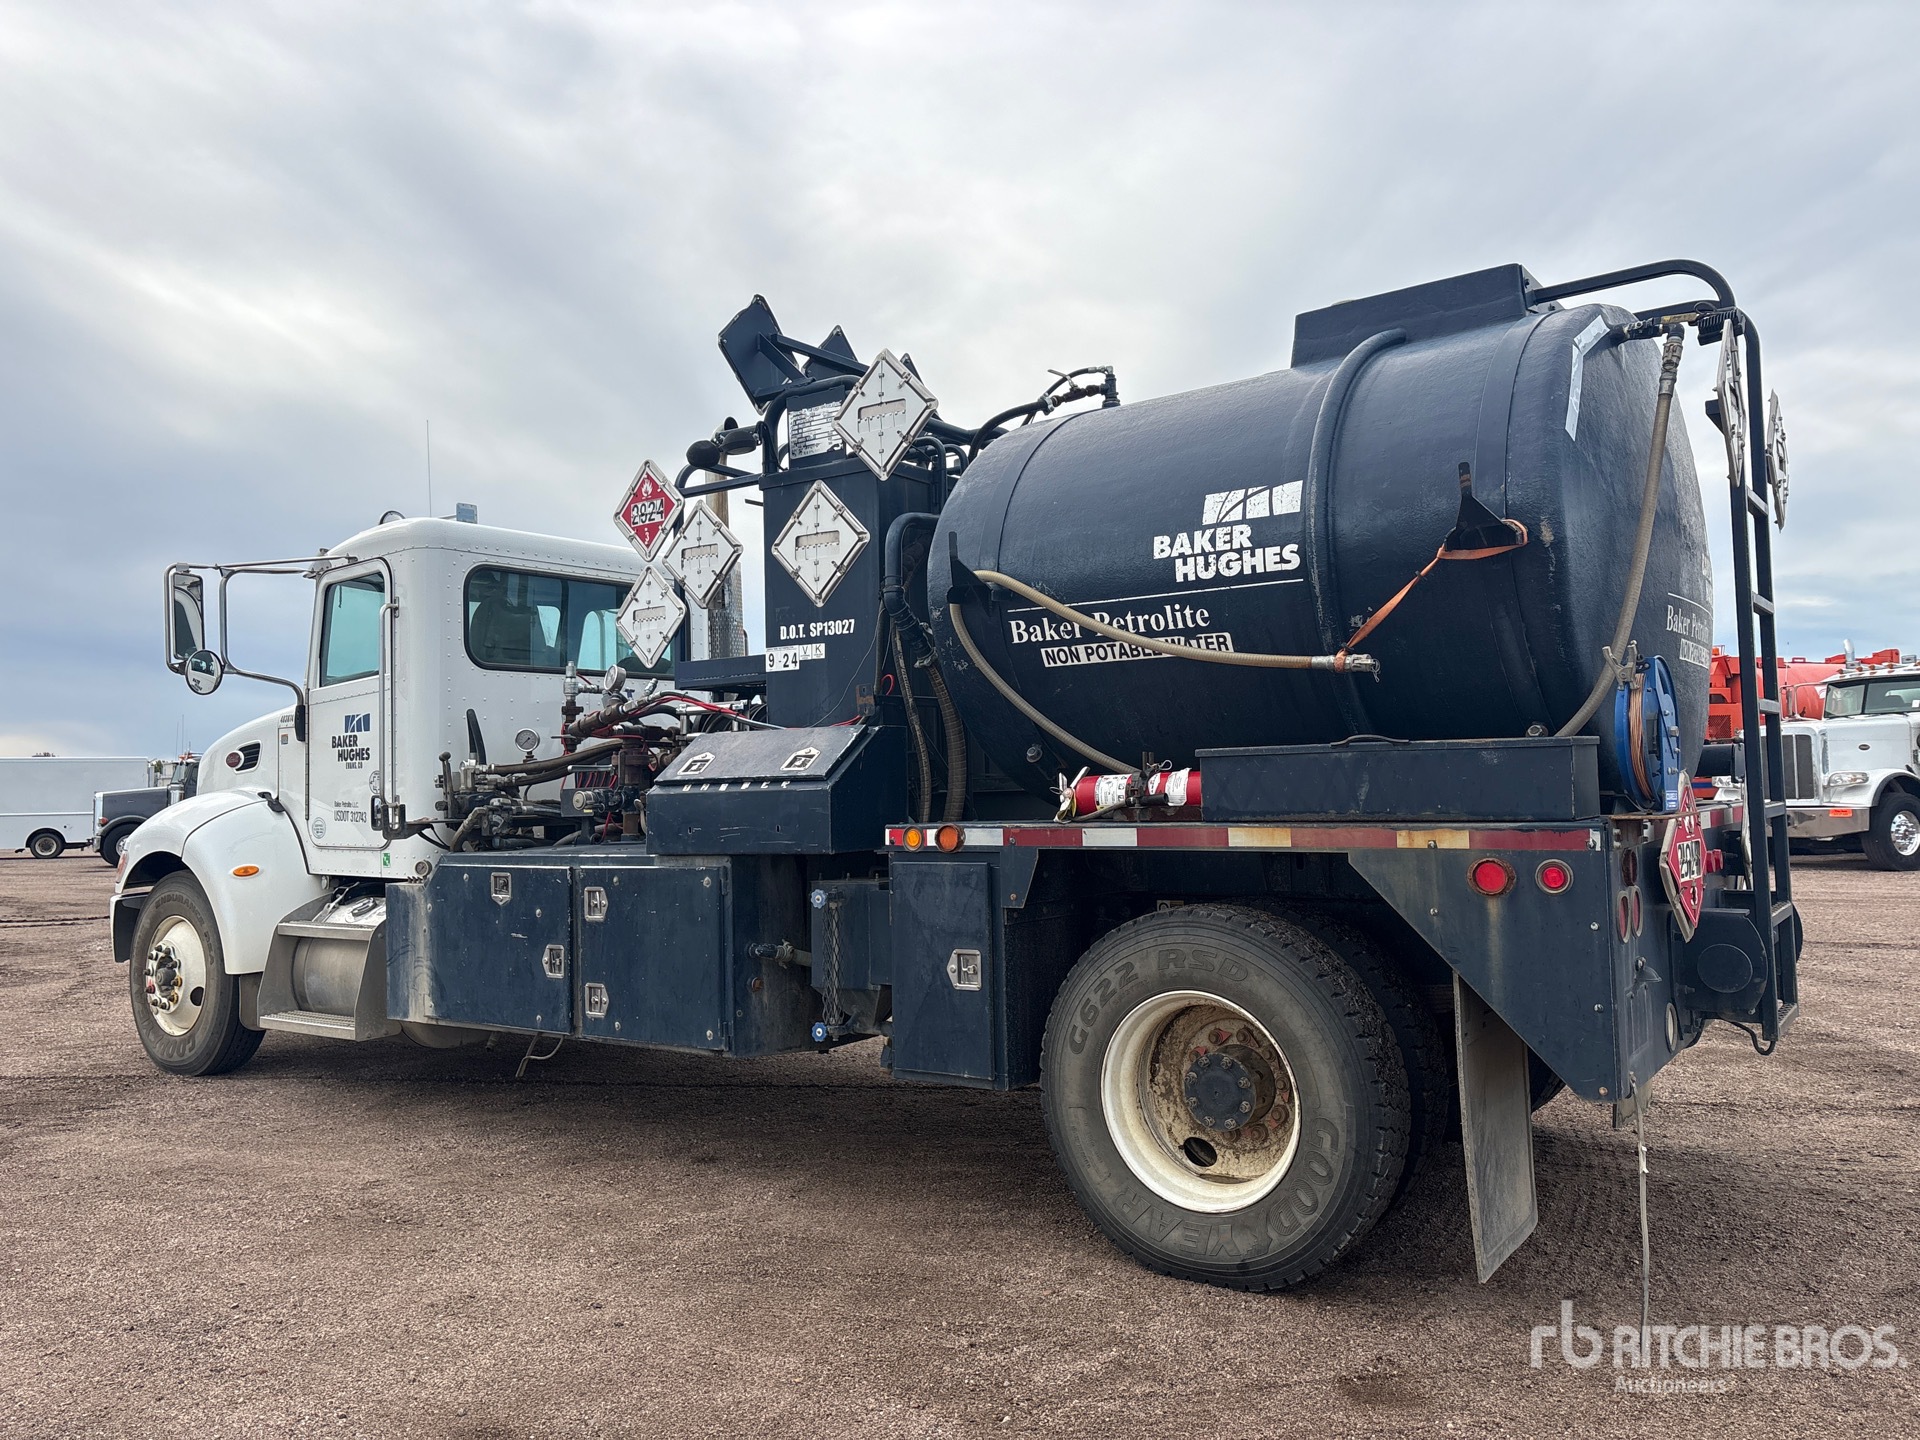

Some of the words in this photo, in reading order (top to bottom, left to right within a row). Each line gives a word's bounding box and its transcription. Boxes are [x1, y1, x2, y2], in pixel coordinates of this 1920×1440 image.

[631, 498, 664, 525] 2924
[1153, 525, 1252, 560] BAKER
[1174, 544, 1301, 582] HUGHES
[780, 624, 806, 640] D.O.T.
[809, 619, 855, 637] SP13027
[1008, 618, 1083, 644] Baker
[1091, 603, 1211, 637] Petrolite
[1666, 604, 1690, 635] Baker
[802, 646, 808, 654] V
[815, 645, 822, 653] K
[1044, 647, 1081, 666] NON
[331, 734, 358, 748] BAKER
[337, 747, 370, 762] HUGHES
[334, 810, 350, 822] USDOT
[1068, 961, 1139, 1054] G622
[1157, 949, 1249, 982] RSD
